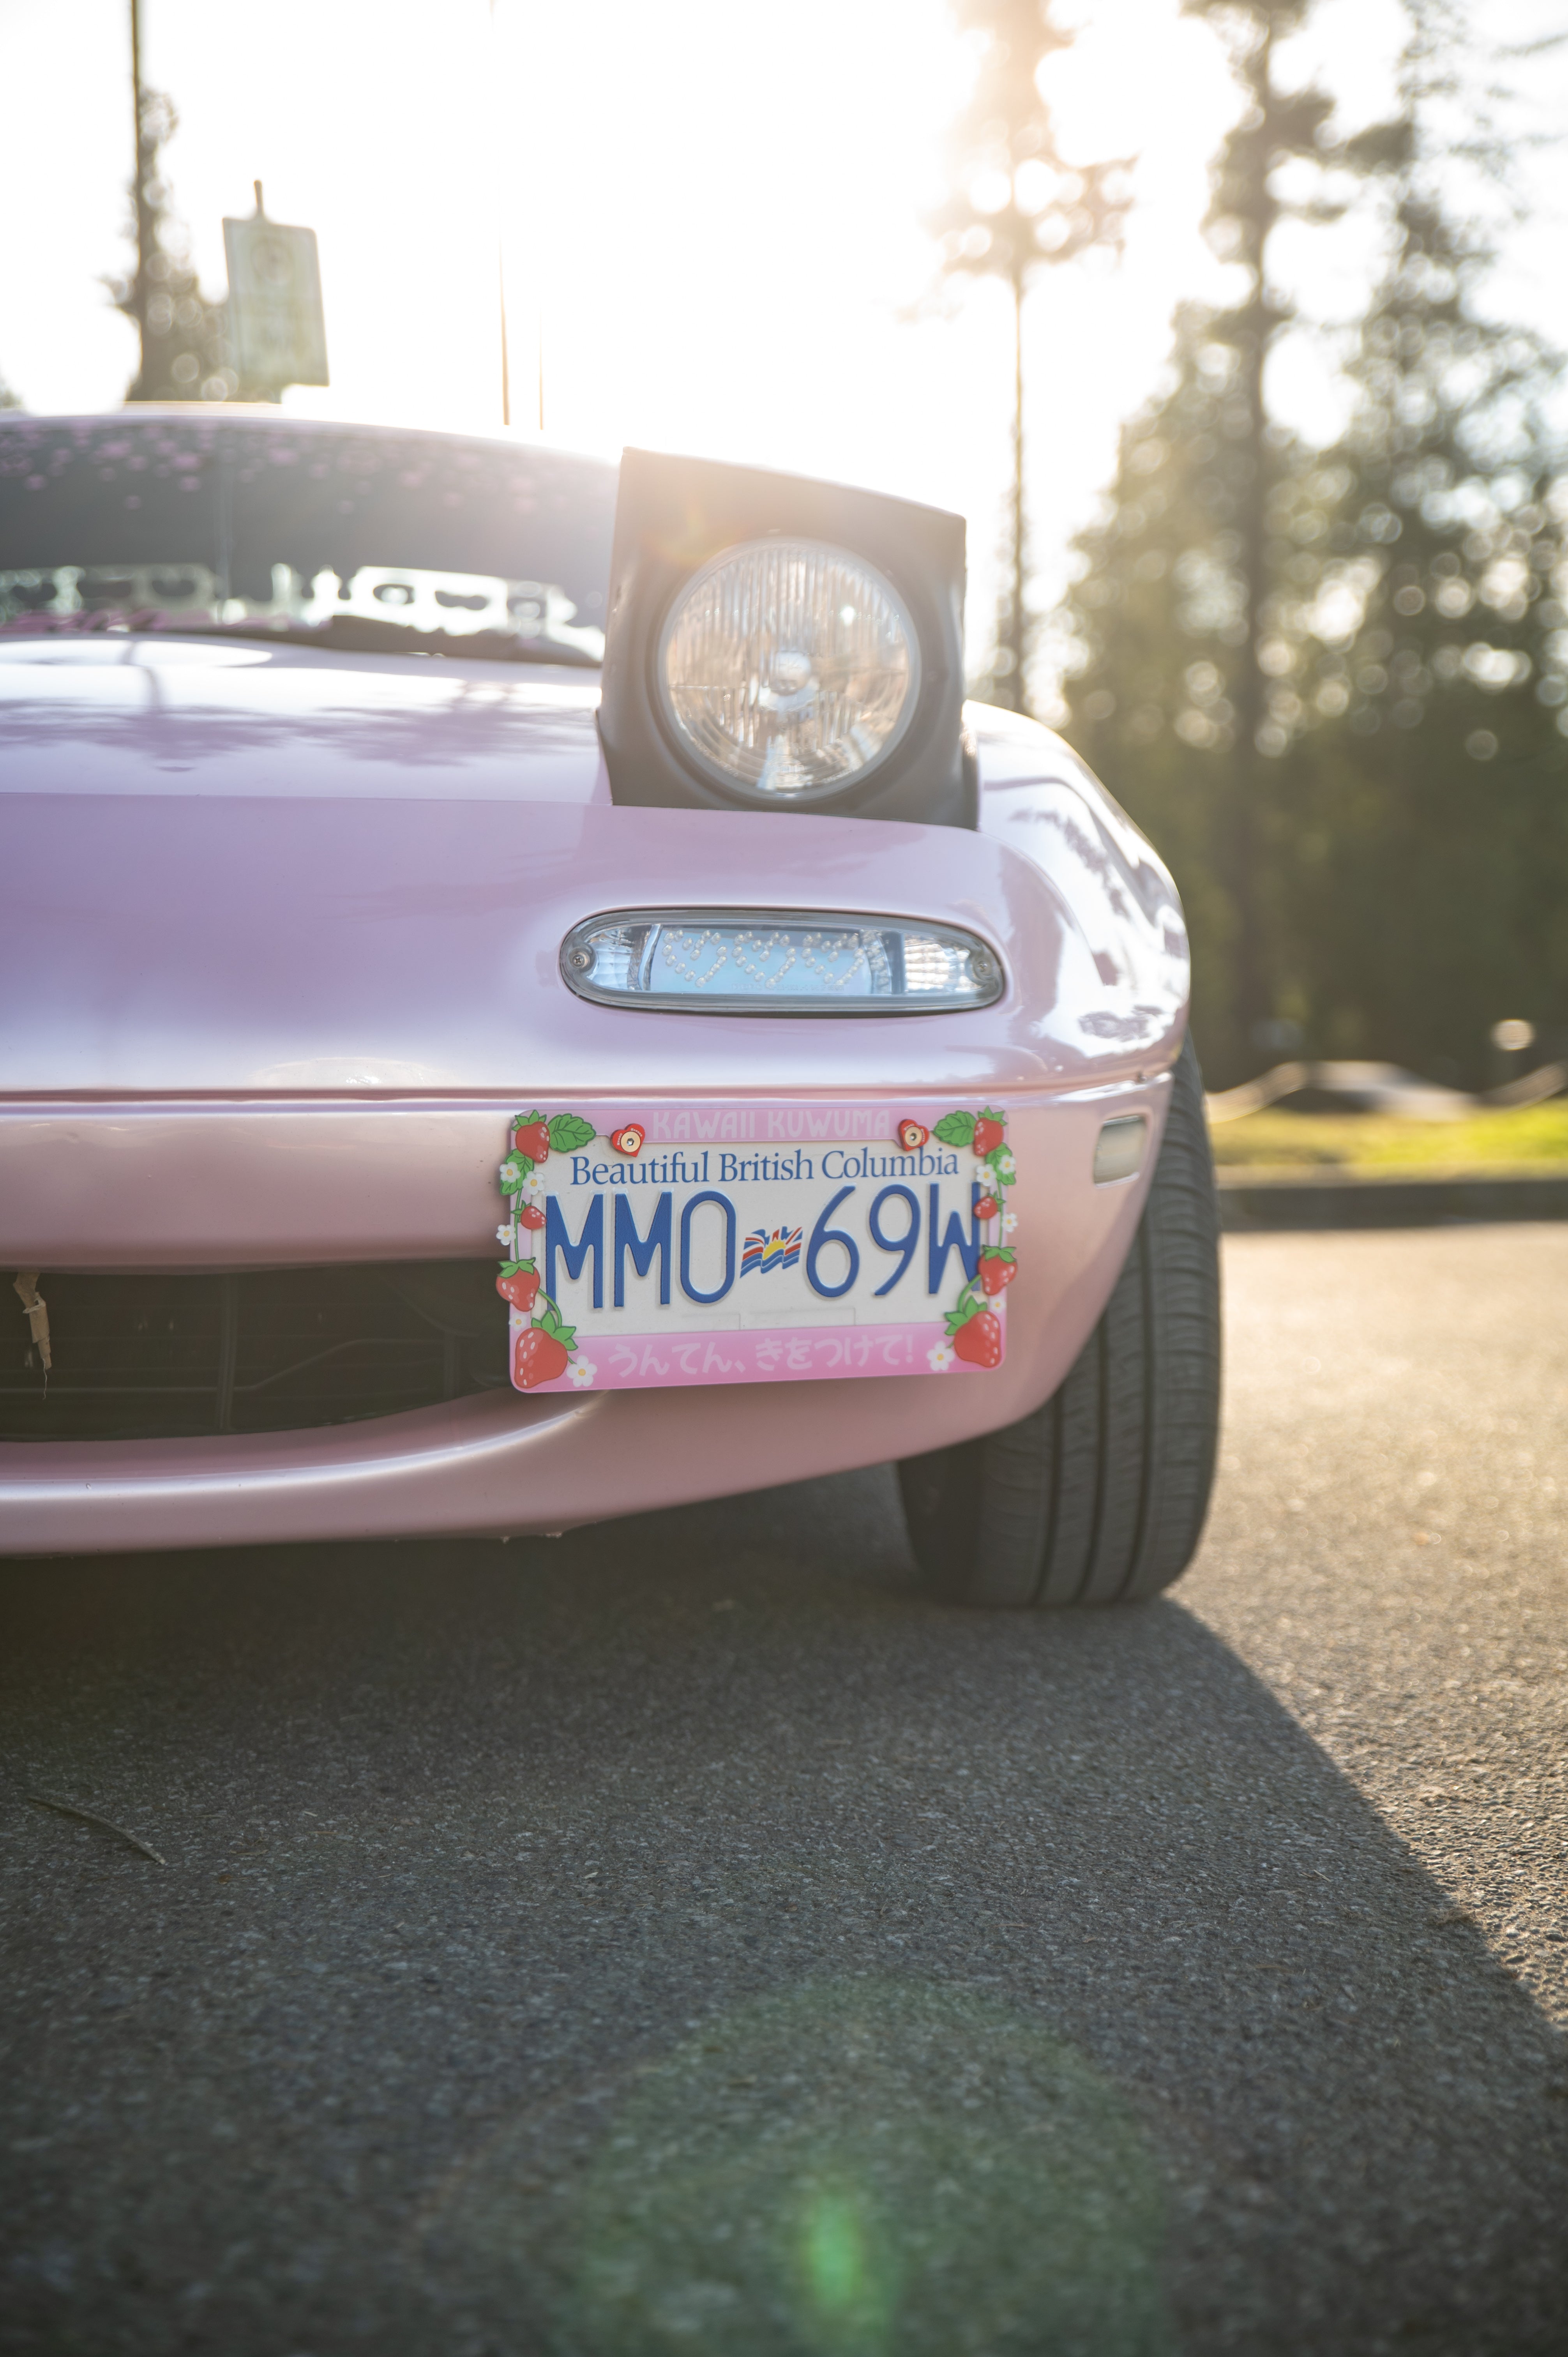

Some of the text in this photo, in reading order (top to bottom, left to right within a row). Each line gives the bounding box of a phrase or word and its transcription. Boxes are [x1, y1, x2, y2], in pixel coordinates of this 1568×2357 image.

[653, 1111, 755, 1140] KAWAII
[768, 1110, 890, 1138] KUWUMA
[570, 1146, 959, 1185] Beautiful British Columbia
[807, 1182, 980, 1298] 69W
